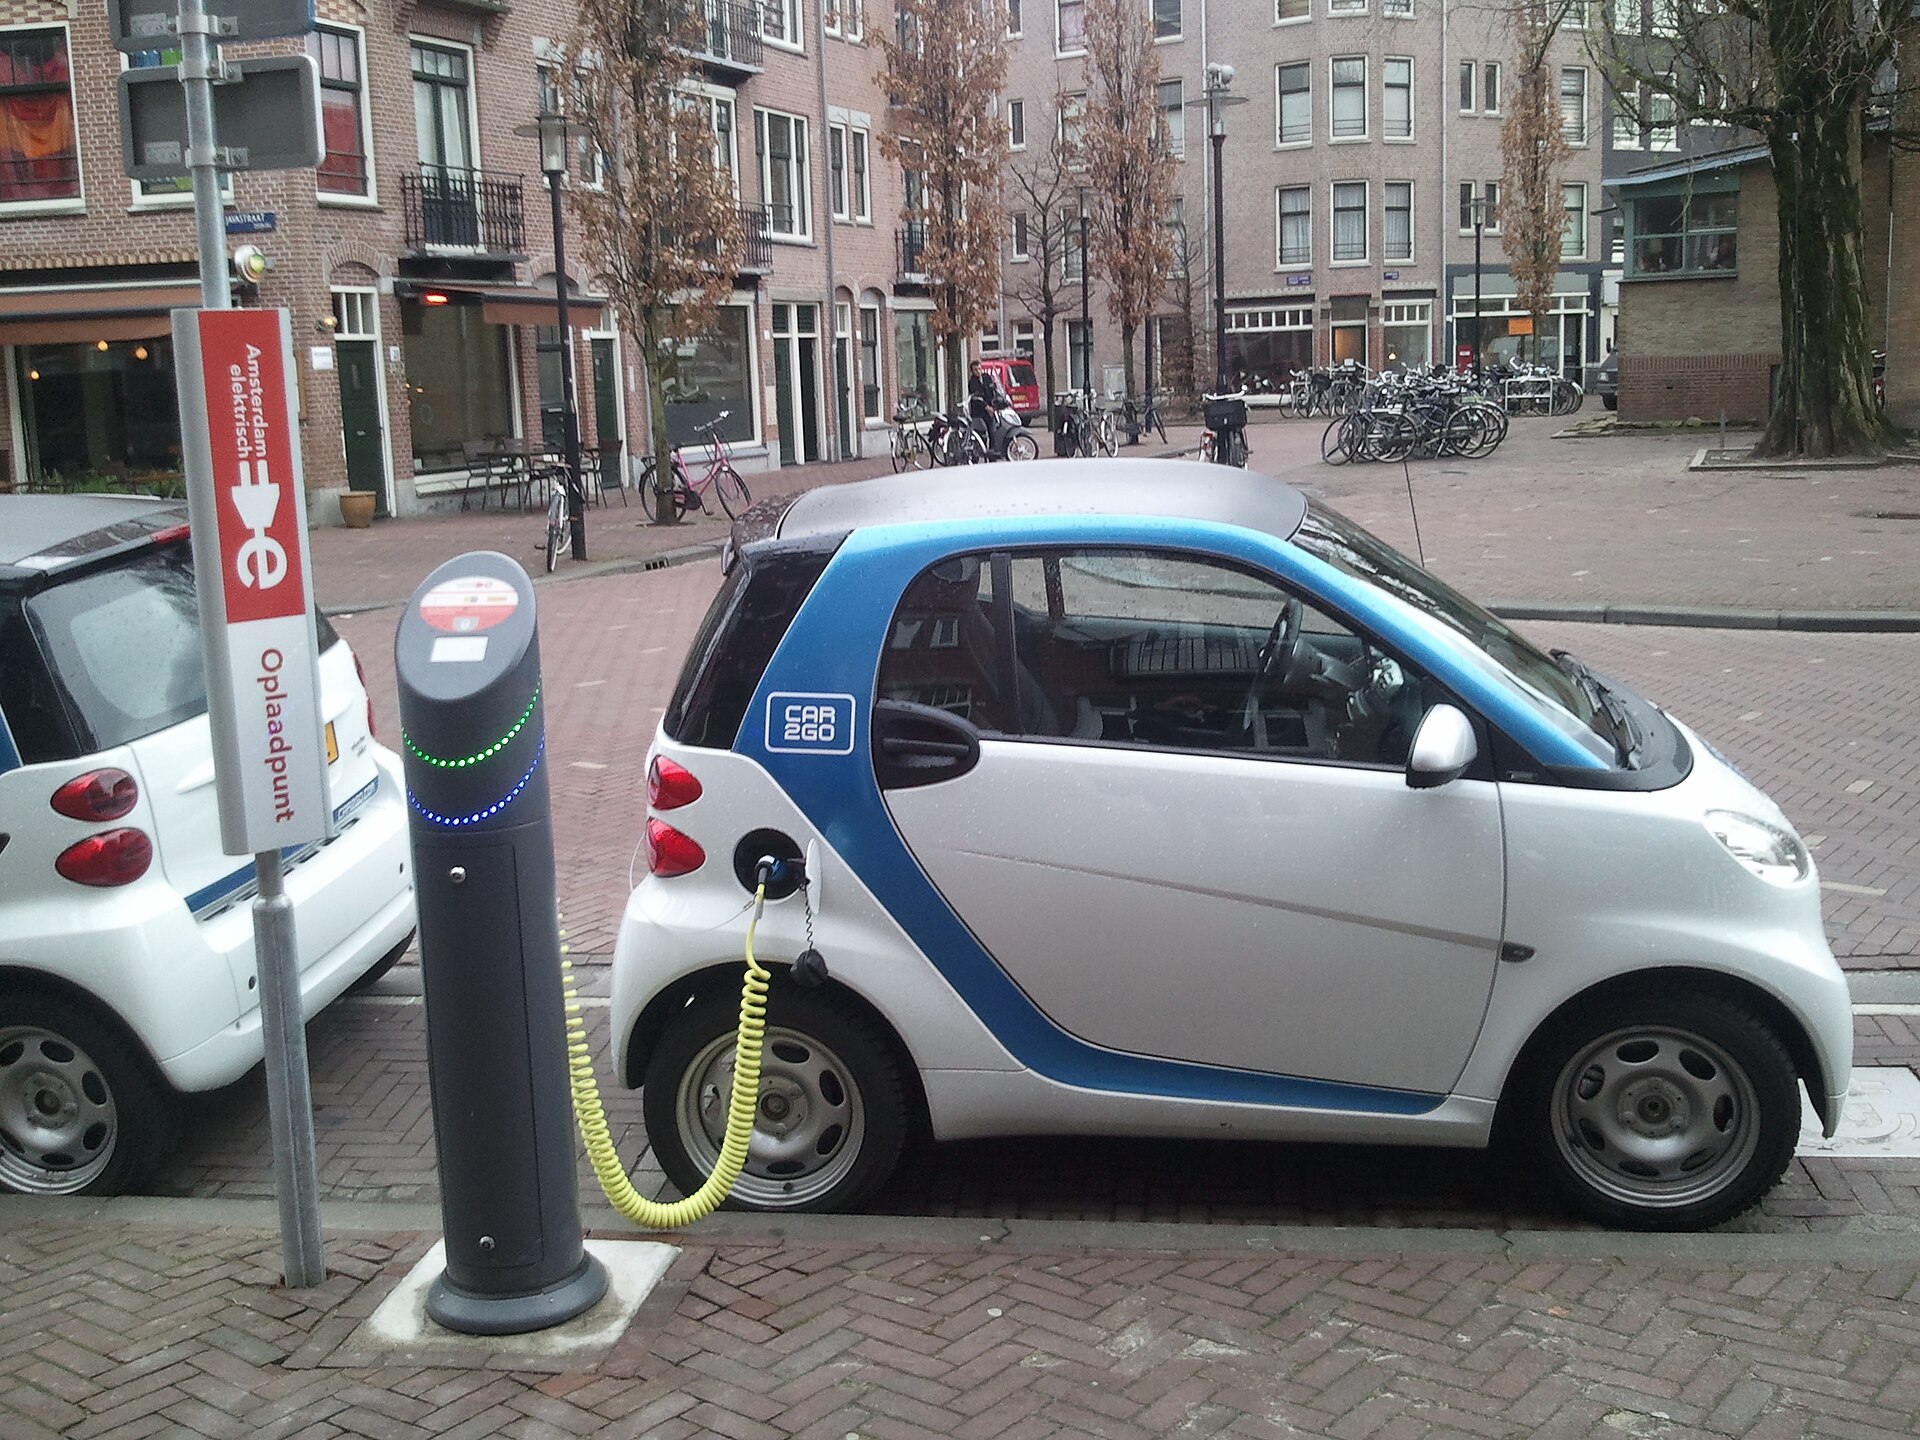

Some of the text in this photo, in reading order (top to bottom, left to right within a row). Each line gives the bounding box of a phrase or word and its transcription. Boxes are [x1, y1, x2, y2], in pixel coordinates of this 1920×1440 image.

[229, 363, 253, 459] elektrisch
[245, 343, 269, 457] Amsterdam
[256, 647, 294, 824] Oplaadpunt
[783, 722, 836, 742] 2GO
[785, 704, 836, 724] CAR
